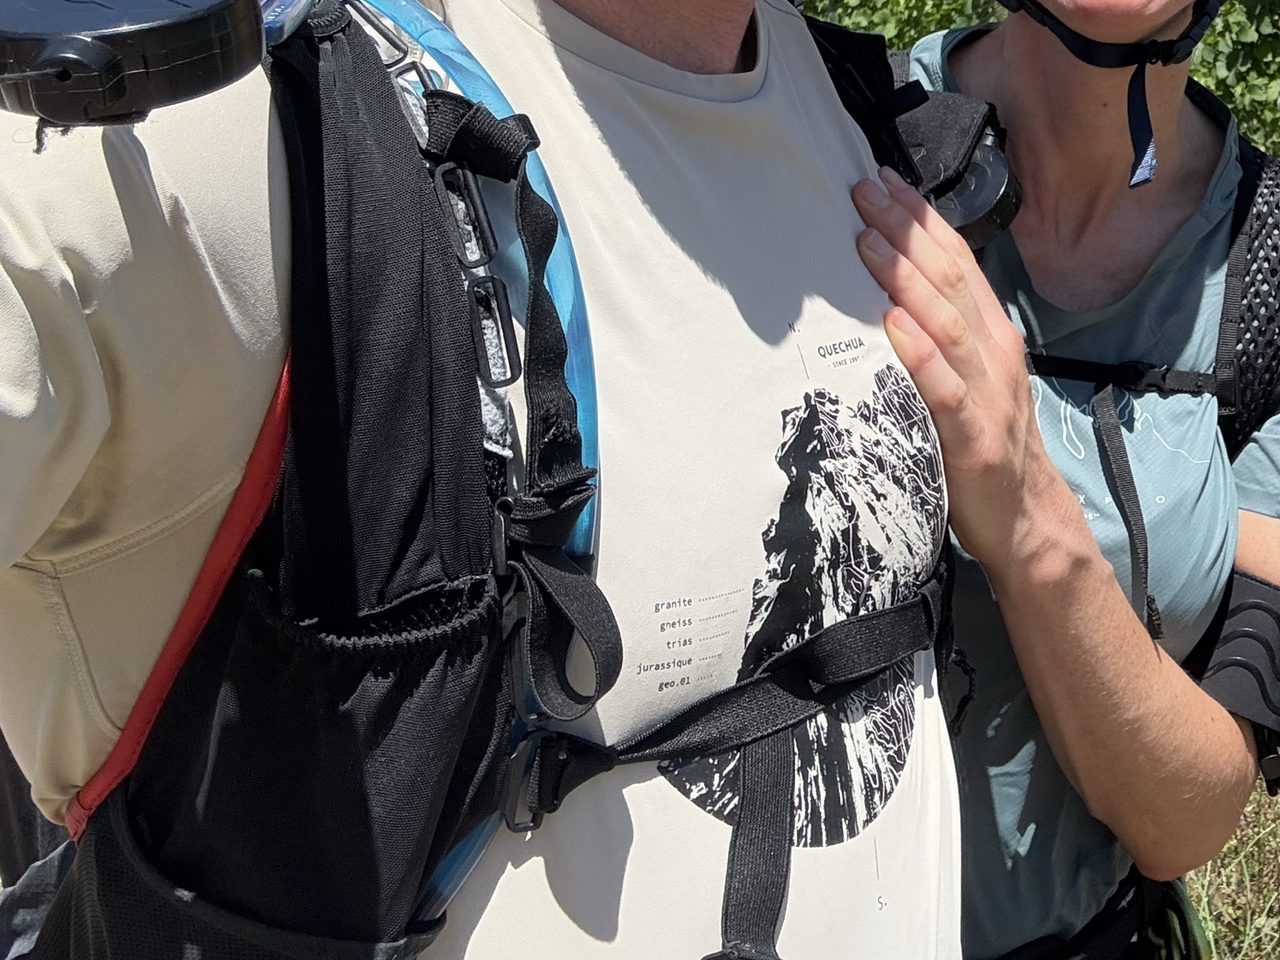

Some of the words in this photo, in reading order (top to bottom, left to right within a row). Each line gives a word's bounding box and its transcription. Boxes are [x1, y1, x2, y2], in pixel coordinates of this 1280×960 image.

[817, 336, 866, 359] QUECHUA
[832, 358, 848, 368] SINCE
[654, 598, 693, 613] granite
[660, 617, 693, 632] gneiss
[666, 637, 693, 649] trias
[636, 657, 693, 675] jurassique
[658, 676, 691, 692] geo.01
